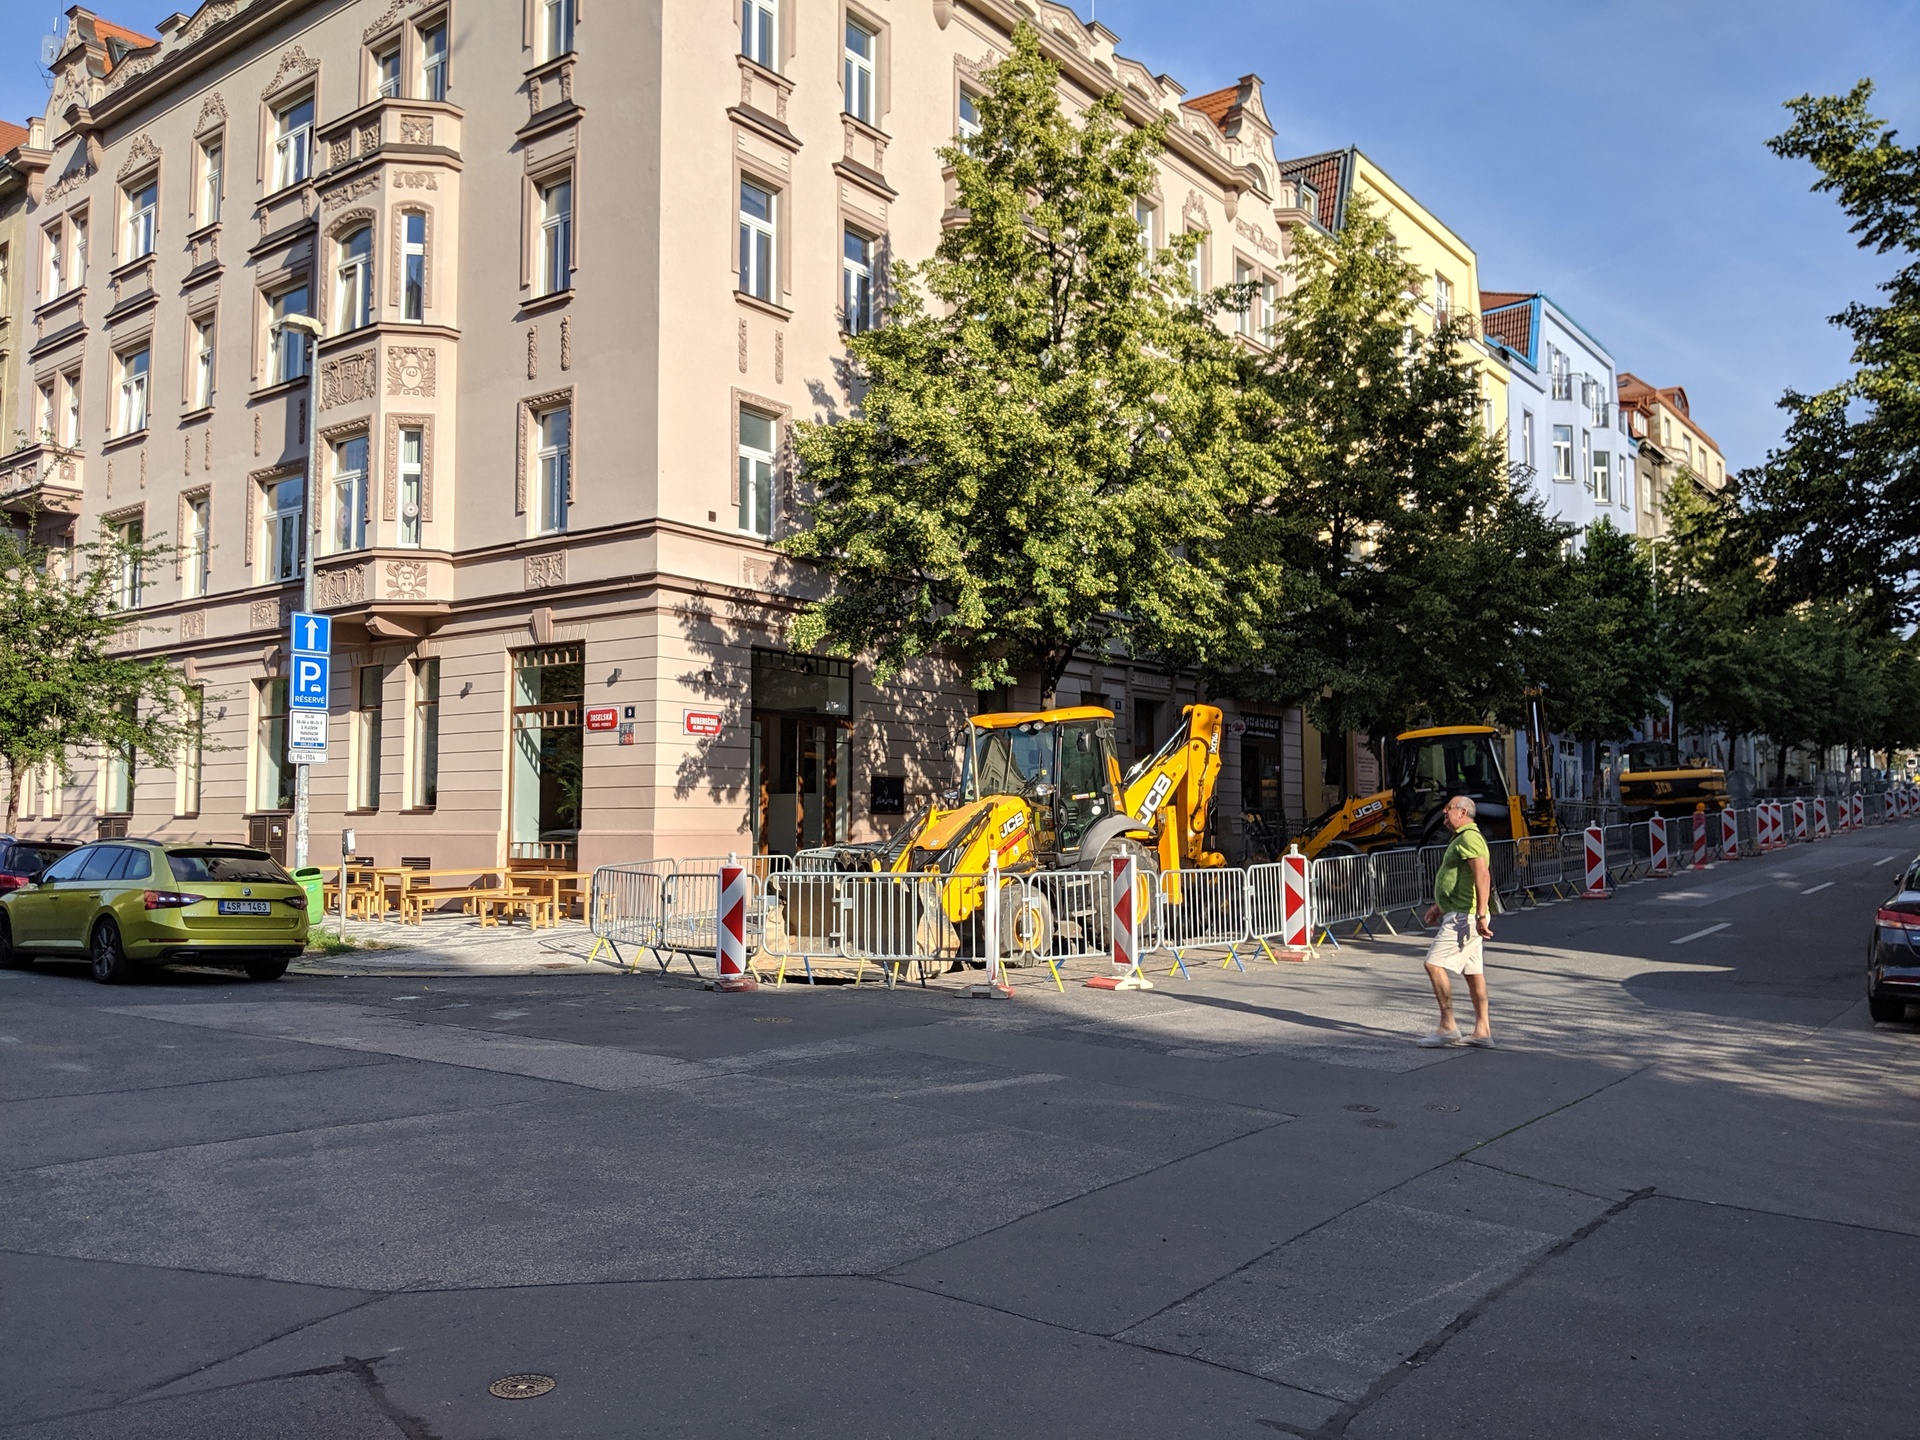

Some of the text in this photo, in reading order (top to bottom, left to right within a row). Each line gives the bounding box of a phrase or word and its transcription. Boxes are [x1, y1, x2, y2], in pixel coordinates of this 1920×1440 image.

[300, 661, 321, 692] P
[295, 694, 325, 704] RÉSERVÉ
[1655, 782, 1672, 795] JCB
[1140, 773, 1172, 825] JCB
[1355, 801, 1383, 818] JCB
[1000, 813, 1025, 838] JCB
[226, 902, 267, 911] 4SR 1463
